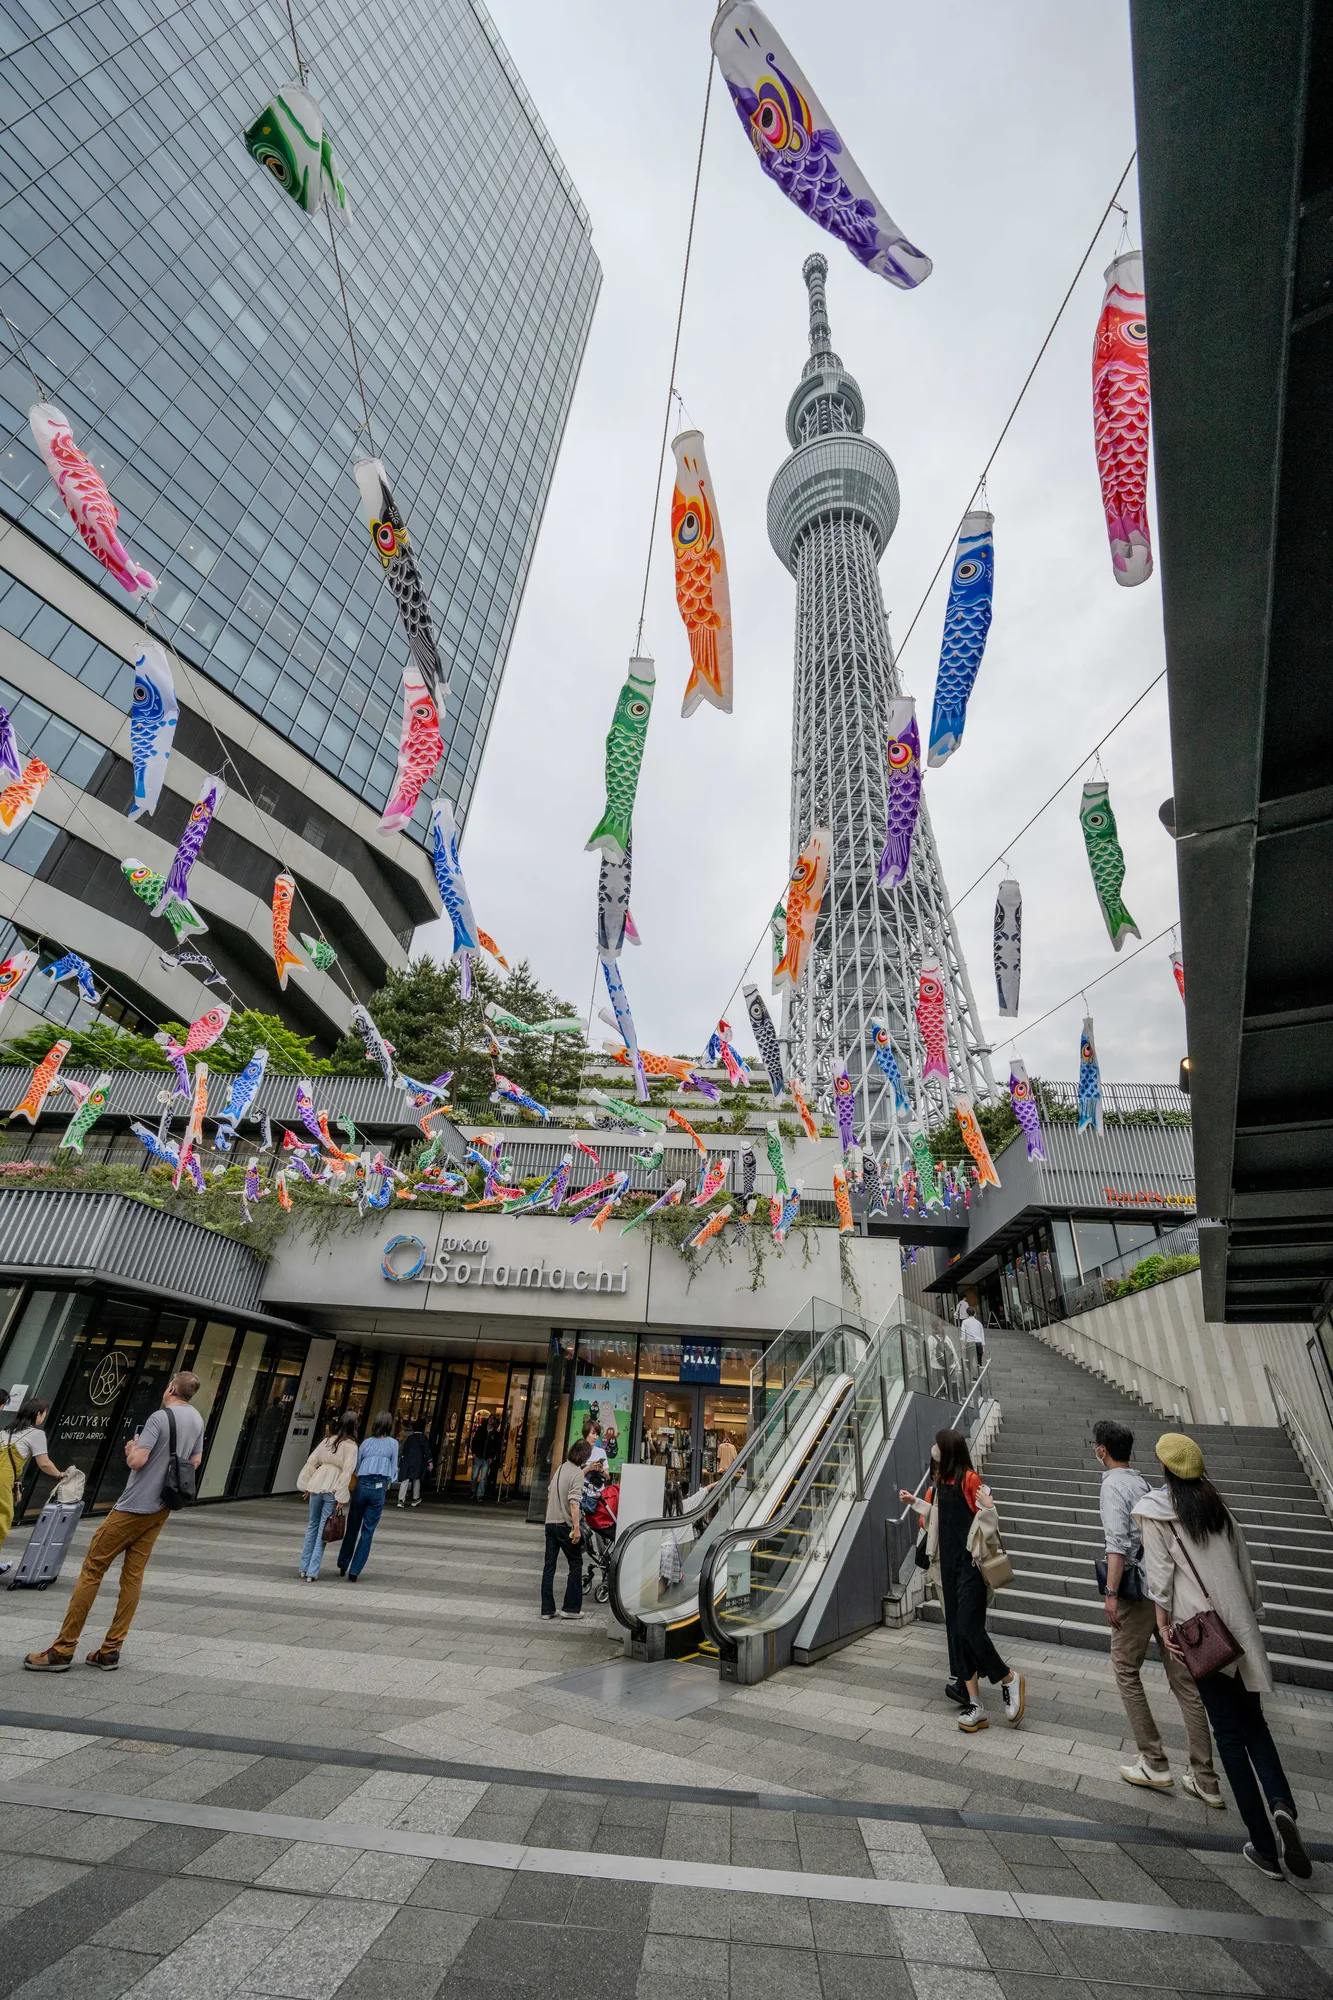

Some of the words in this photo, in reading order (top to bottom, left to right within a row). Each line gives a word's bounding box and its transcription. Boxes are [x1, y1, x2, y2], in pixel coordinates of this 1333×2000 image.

[1102, 1187, 1164, 1205] TULLY'S
[1166, 1193, 1197, 1206] COF
[439, 1237, 490, 1253] TOKYO
[431, 1252, 628, 1293] Solamachi
[683, 1354, 717, 1365] PLAZA
[60, 1431, 85, 1440] UNITED
[85, 1432, 107, 1440] ARRO
